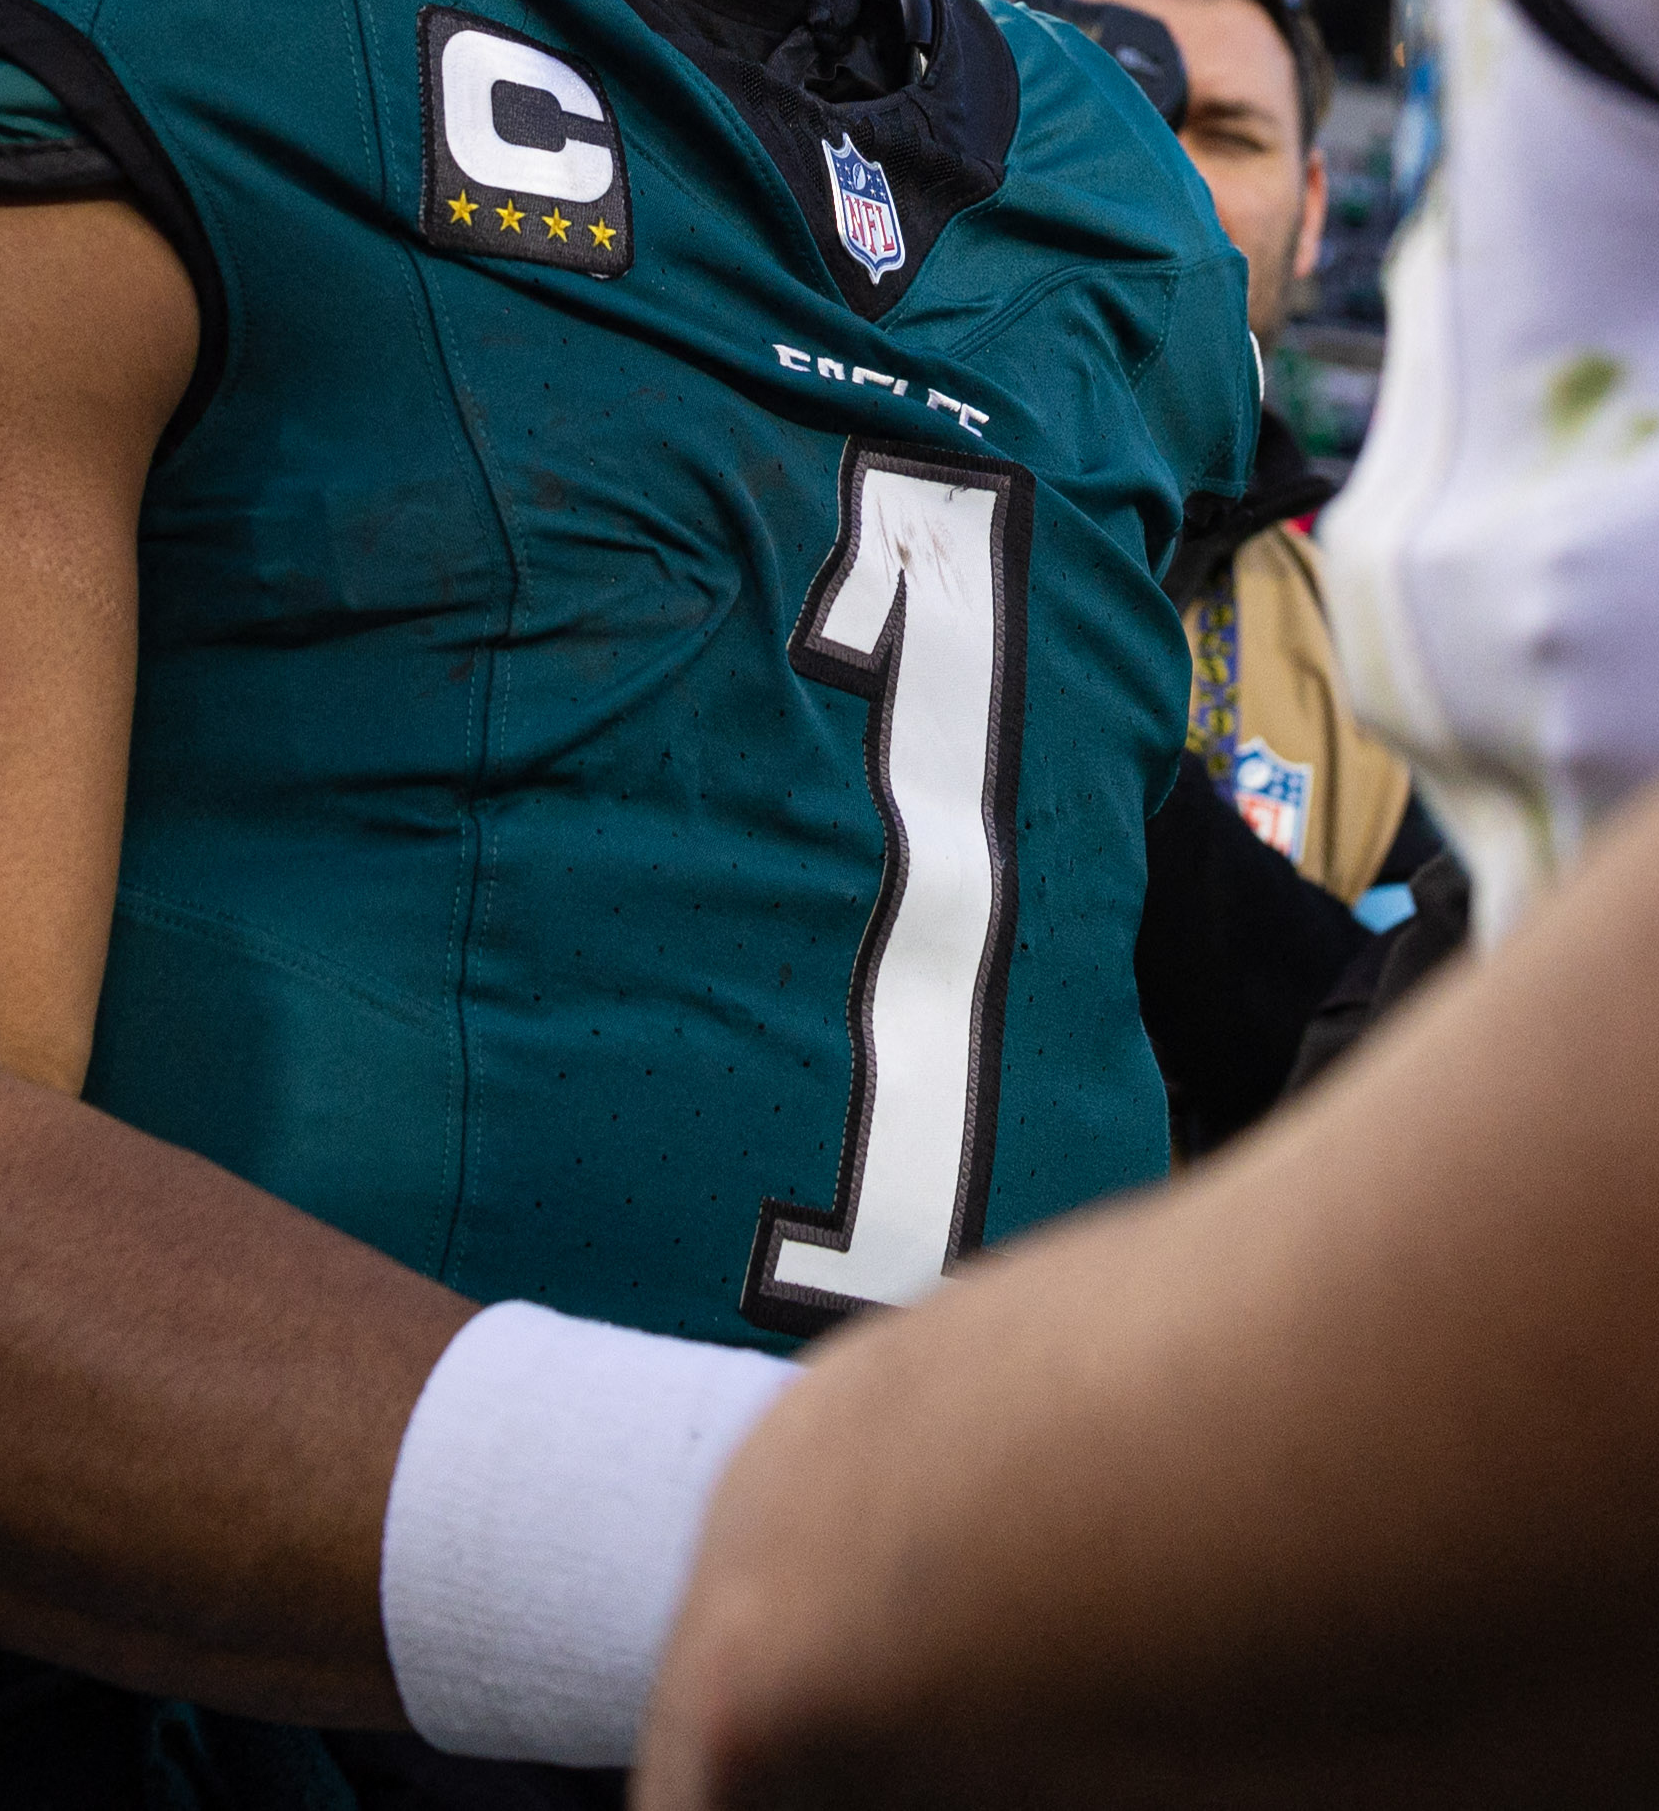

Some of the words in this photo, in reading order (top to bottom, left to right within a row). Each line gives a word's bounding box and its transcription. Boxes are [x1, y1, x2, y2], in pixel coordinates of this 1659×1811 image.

[441, 29, 614, 204] C
[845, 194, 896, 257] NFL
[741, 435, 1035, 1335] 1
